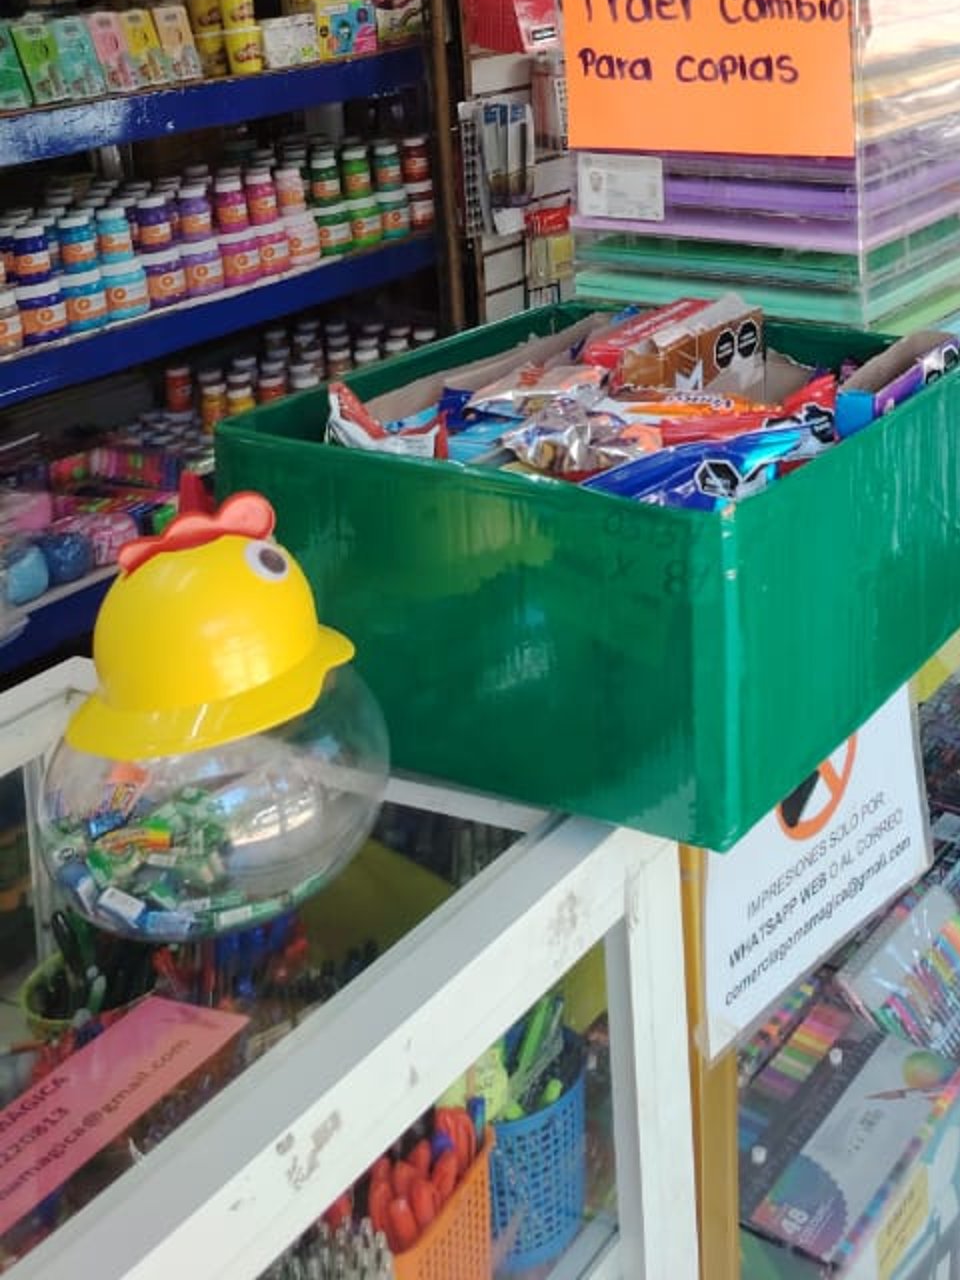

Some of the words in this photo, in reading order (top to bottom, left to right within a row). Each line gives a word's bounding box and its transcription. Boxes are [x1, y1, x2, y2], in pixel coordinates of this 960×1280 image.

[676, 53, 800, 85] copias
[729, 897, 798, 968] WHATSAPP
[799, 872, 827, 905] WEB
[829, 863, 839, 879] O
[840, 852, 855, 869] AL
[856, 808, 904, 855] CORREO
[747, 840, 828, 917] IMPRESIONES
[829, 813, 859, 849] SOLO
[861, 791, 887, 821] POR
